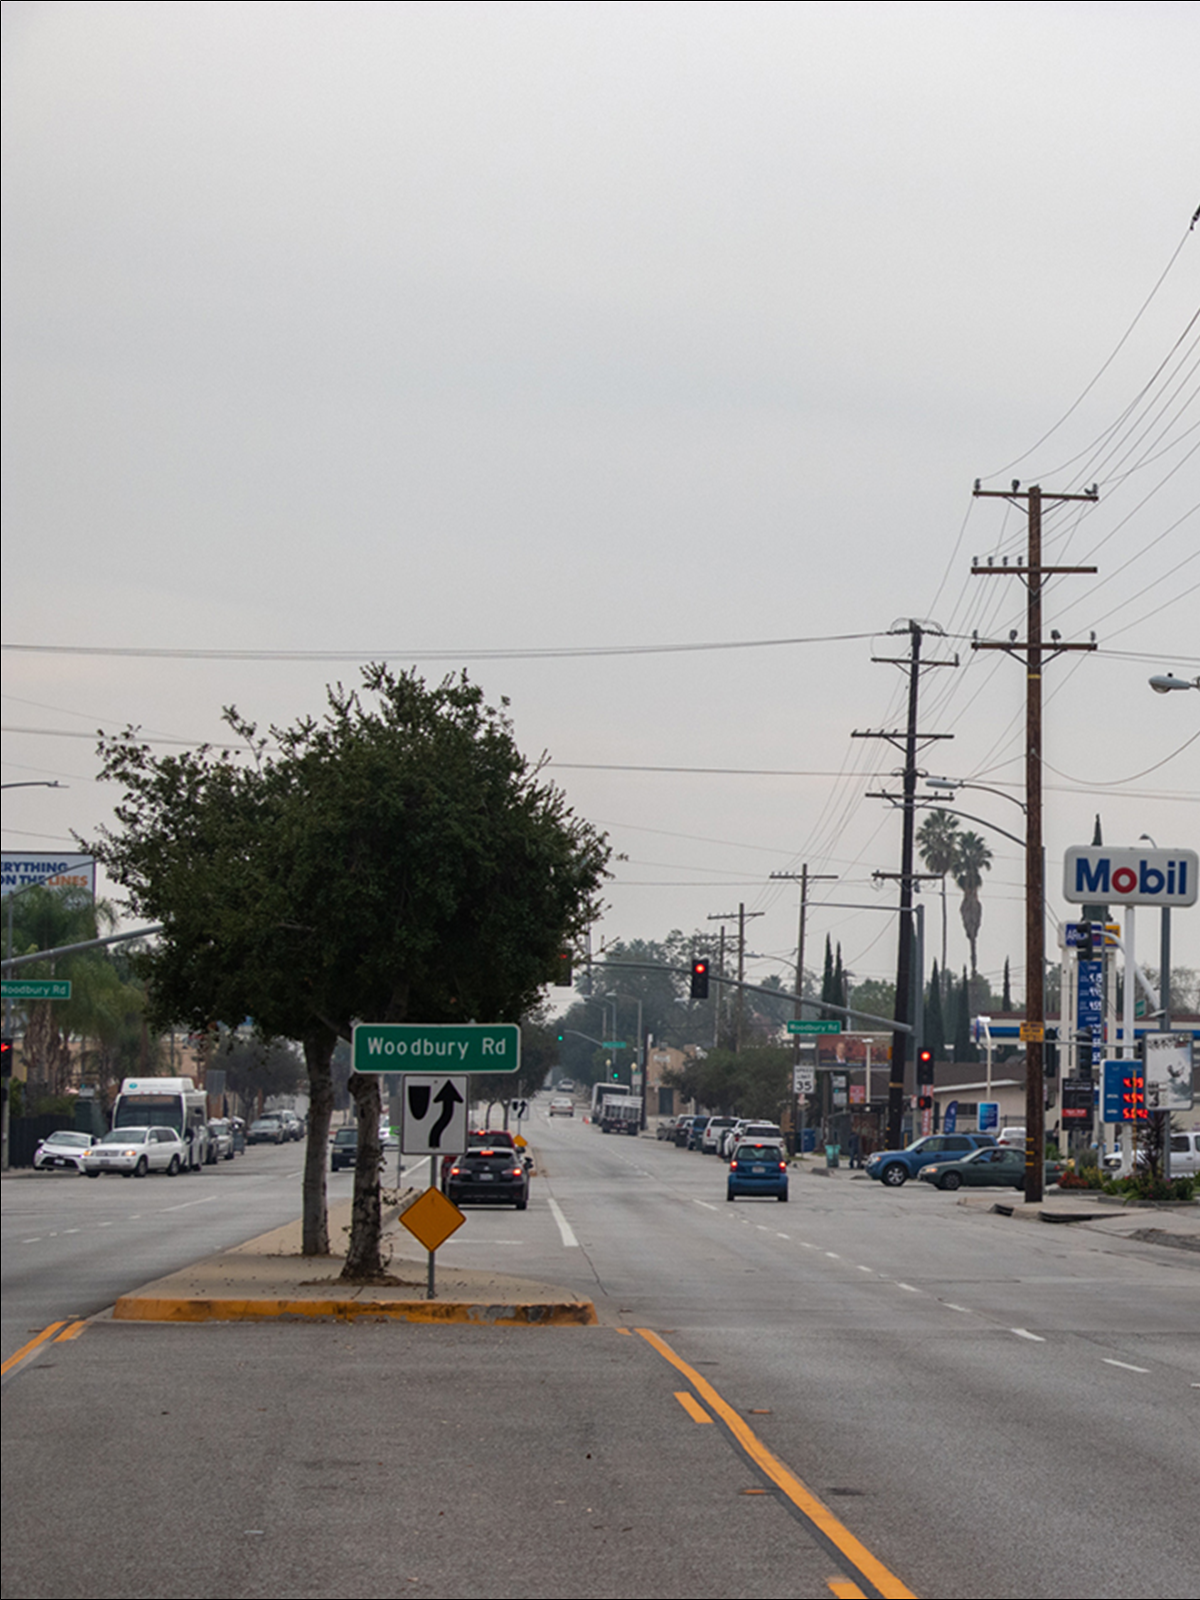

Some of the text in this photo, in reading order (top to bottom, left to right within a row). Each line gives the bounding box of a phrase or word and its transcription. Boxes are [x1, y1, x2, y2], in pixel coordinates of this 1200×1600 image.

[19, 875, 46, 886] THE
[48, 875, 88, 887] LINES
[1075, 858, 1187, 895] Mobil
[53, 985, 66, 995] Rd
[789, 1024, 826, 1032] Woodbury
[368, 1037, 506, 1060] Woodbury Rd
[796, 1080, 812, 1091] 35
